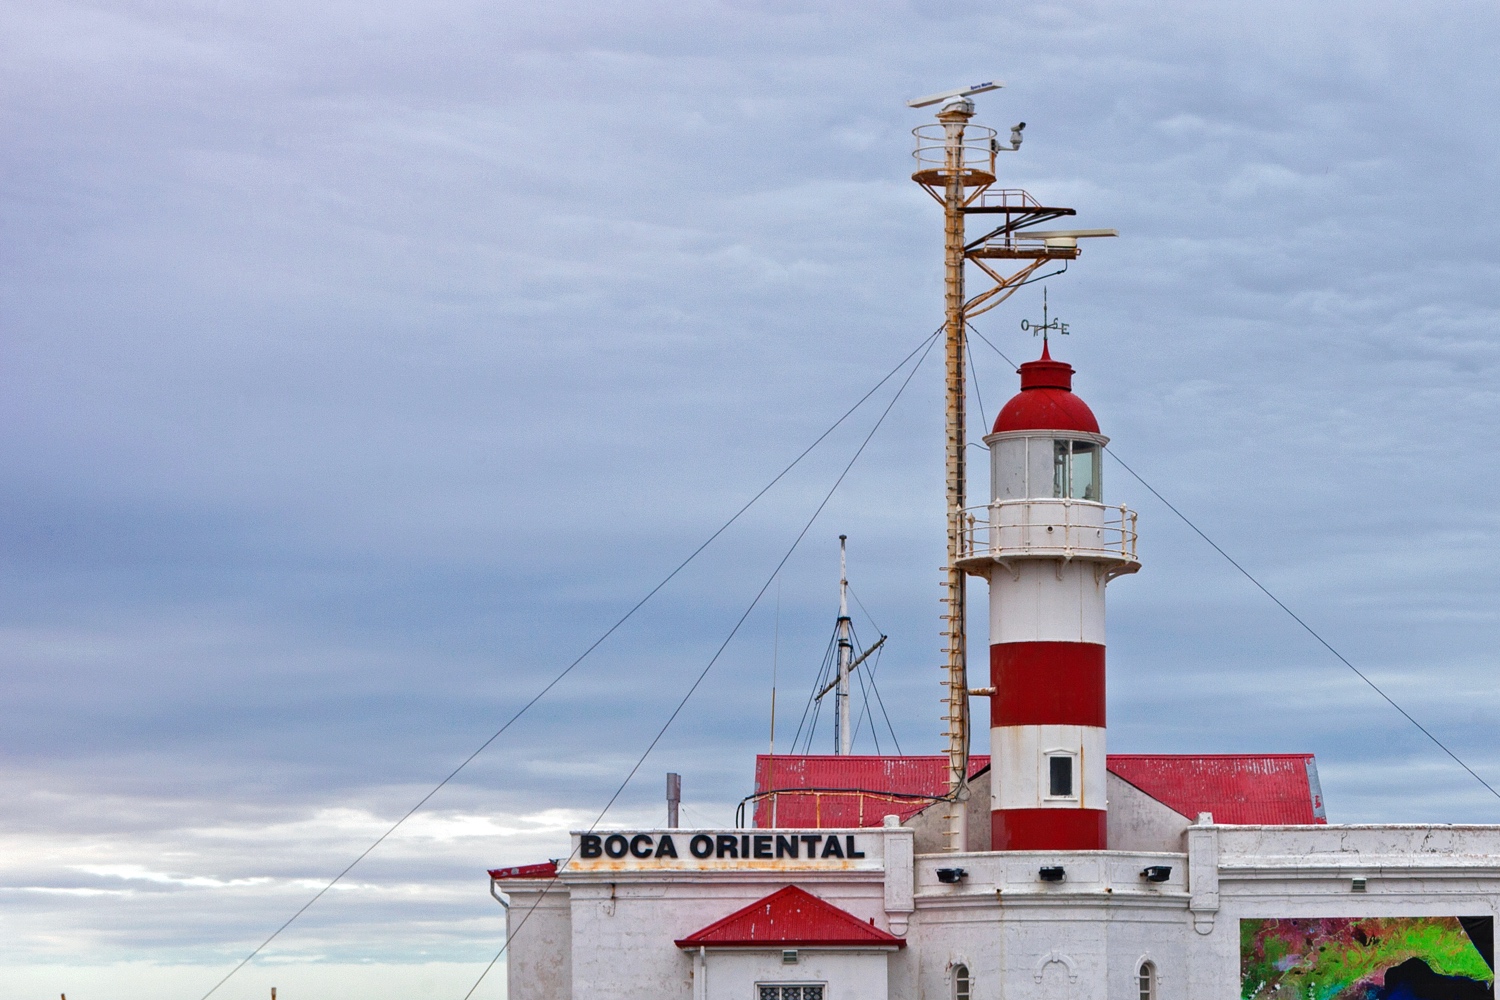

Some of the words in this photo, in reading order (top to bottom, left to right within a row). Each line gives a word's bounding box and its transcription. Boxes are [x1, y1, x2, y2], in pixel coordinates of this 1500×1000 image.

[1061, 323, 1070, 335] E
[580, 834, 678, 859] BOCA
[689, 834, 865, 859] ORIENTAL
